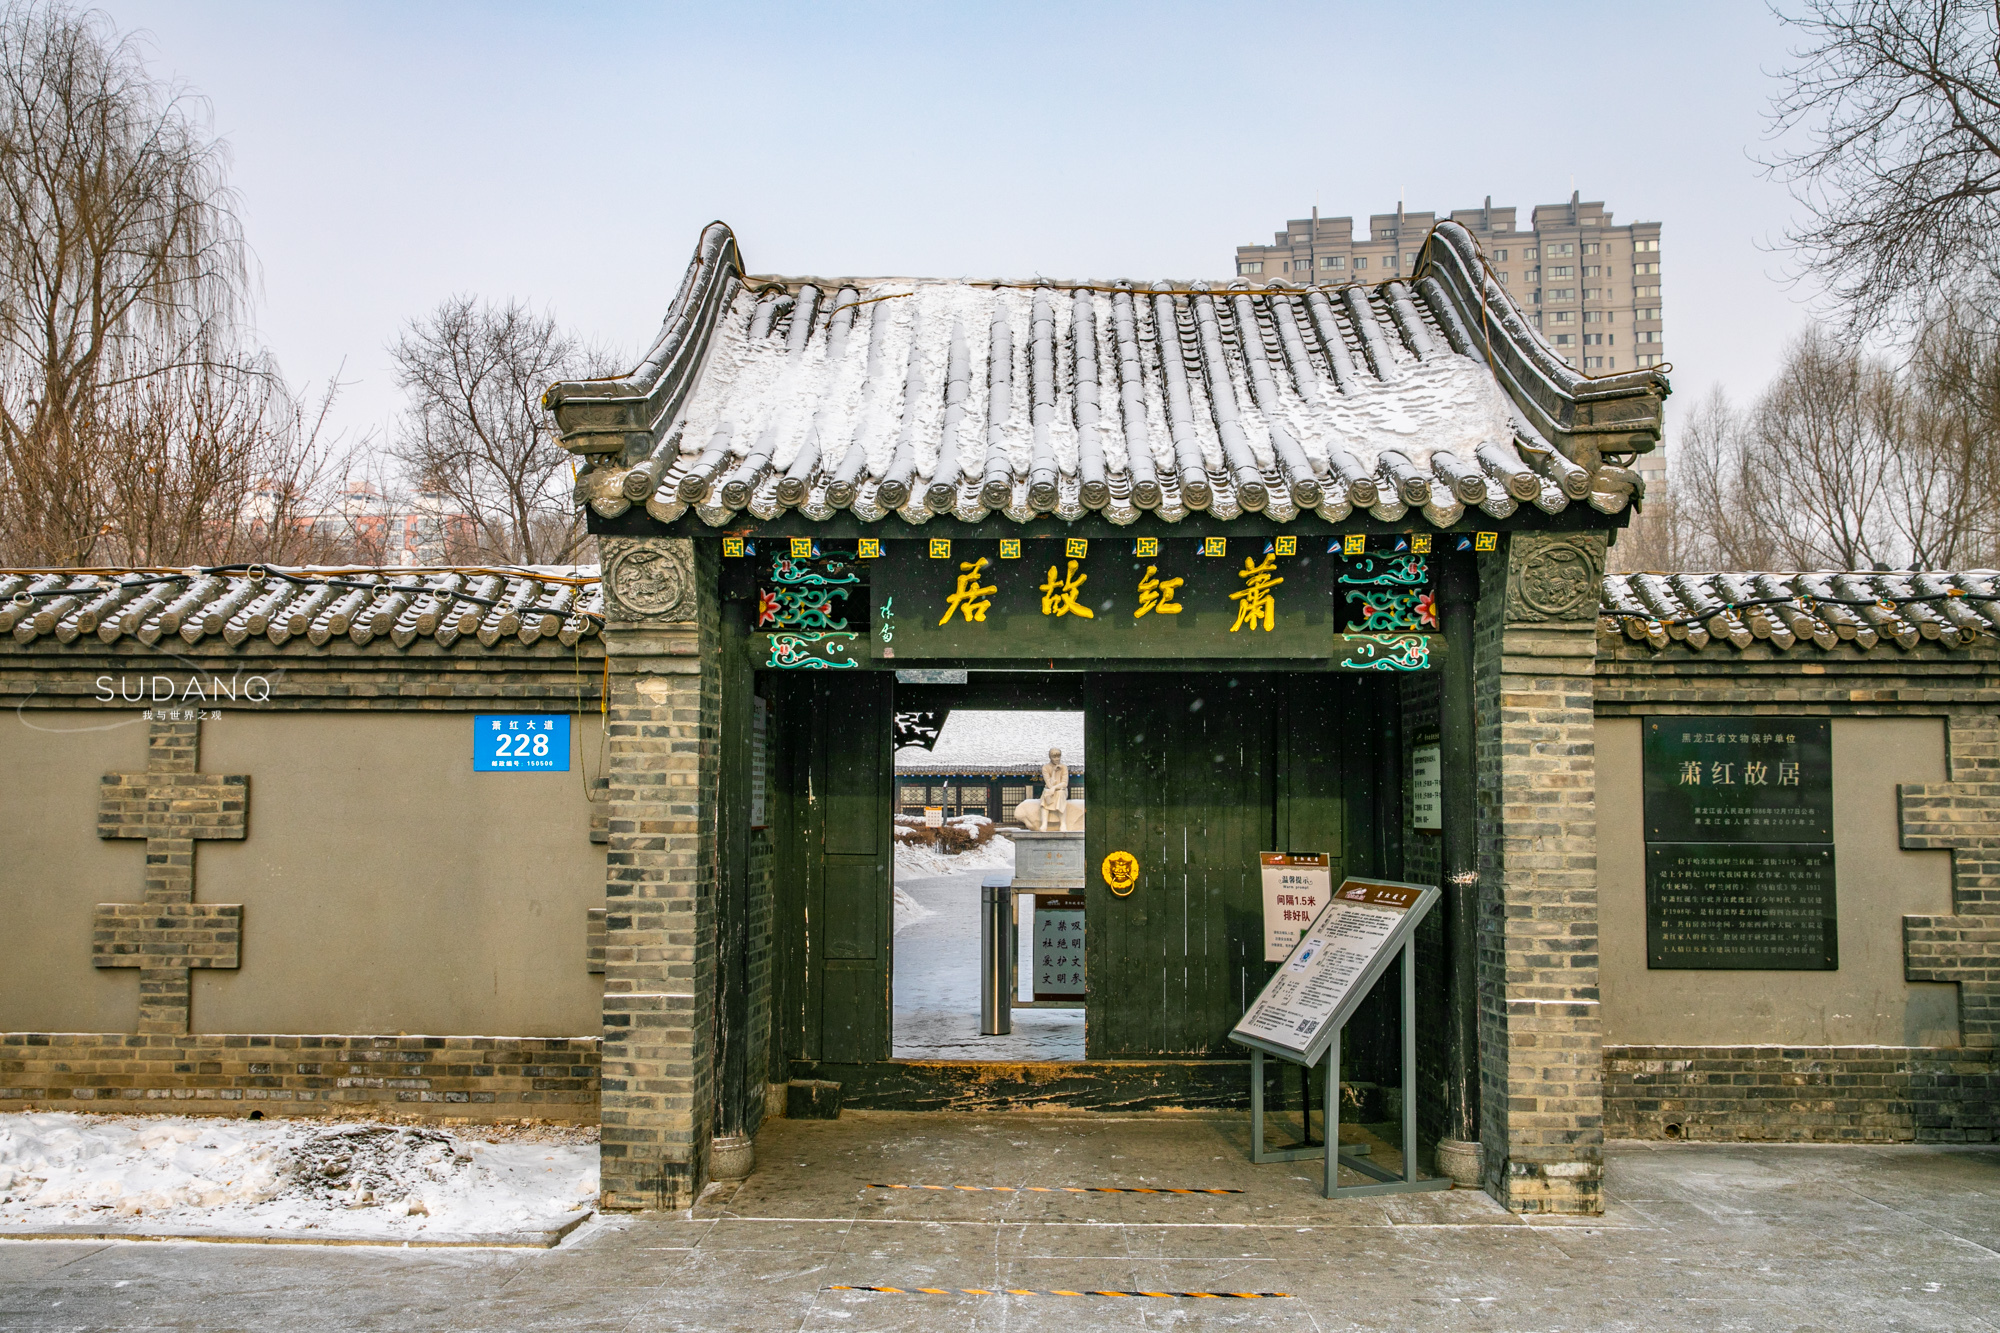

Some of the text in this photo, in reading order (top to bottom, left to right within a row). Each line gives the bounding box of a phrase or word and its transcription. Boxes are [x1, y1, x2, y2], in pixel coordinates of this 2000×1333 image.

[491, 720, 554, 731] 萧红大道
[1681, 732, 1796, 744] 黑龙江省文物保护单位
[495, 733, 549, 757] 228
[1678, 760, 1800, 786] 萧红故居
[1276, 894, 1316, 907] 间隔1.5米
[1283, 909, 1311, 922] 排好队
